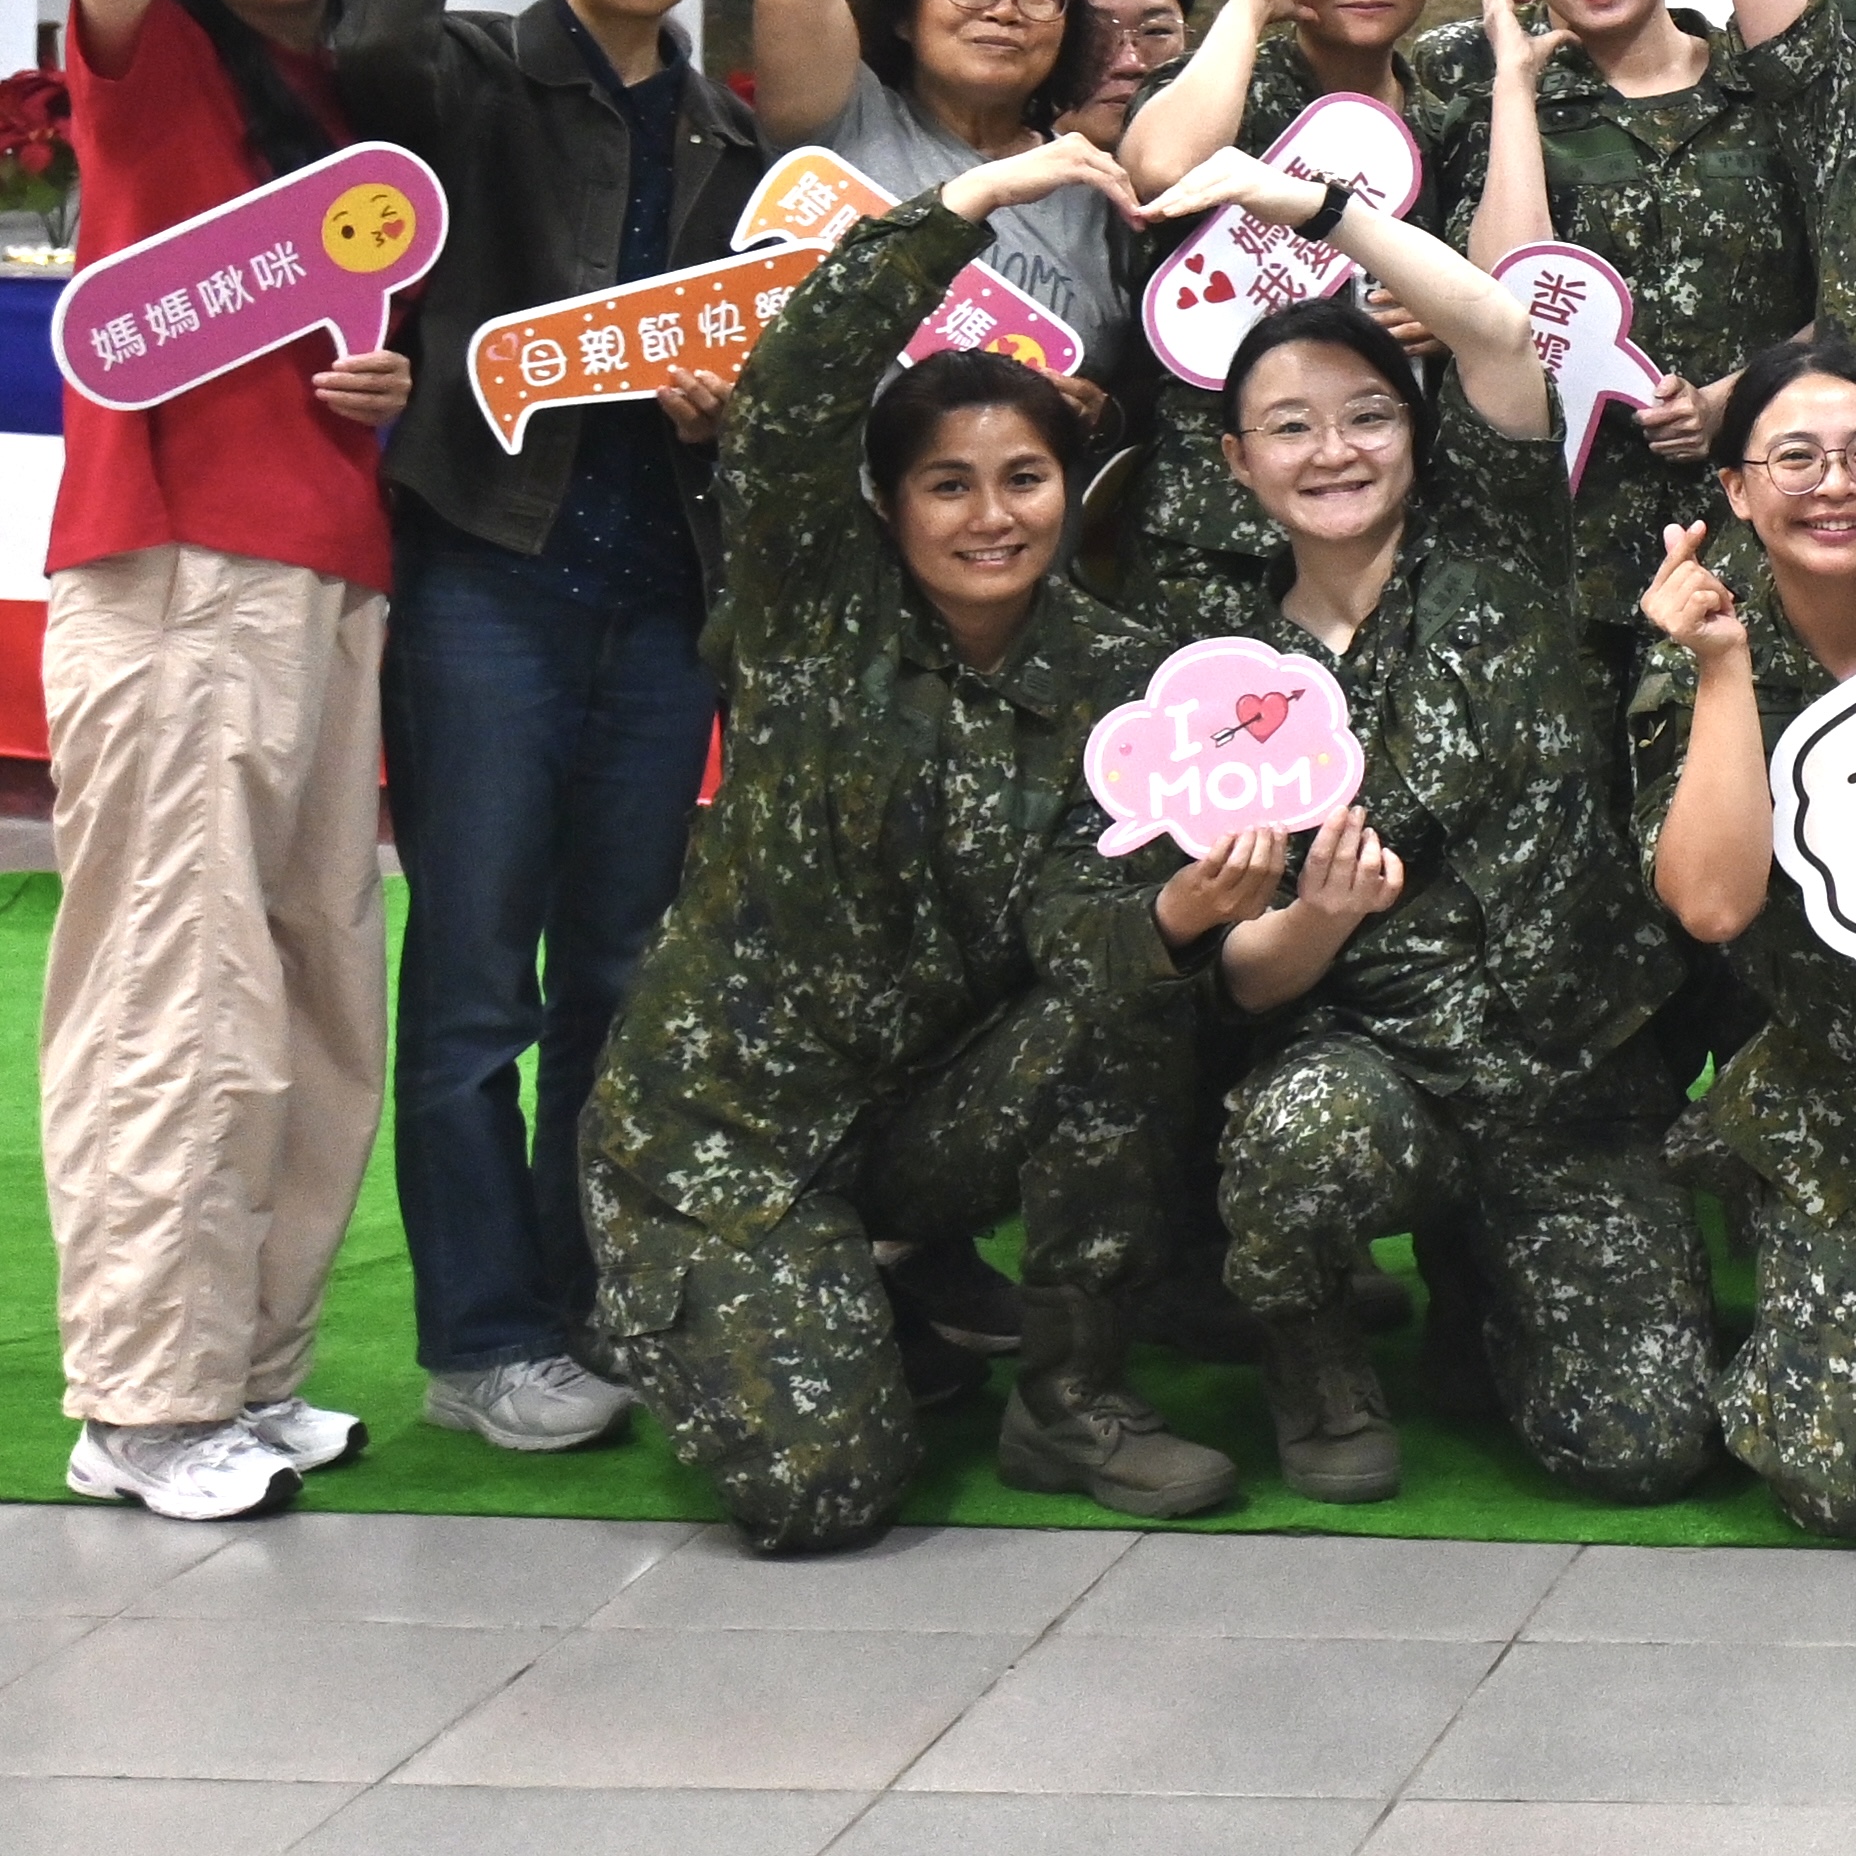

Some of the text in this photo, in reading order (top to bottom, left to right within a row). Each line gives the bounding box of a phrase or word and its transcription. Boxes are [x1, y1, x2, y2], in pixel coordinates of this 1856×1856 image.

[90, 240, 308, 372] 媽媽啾咪
[1165, 698, 1203, 762] I
[1149, 756, 1312, 819] MOM
